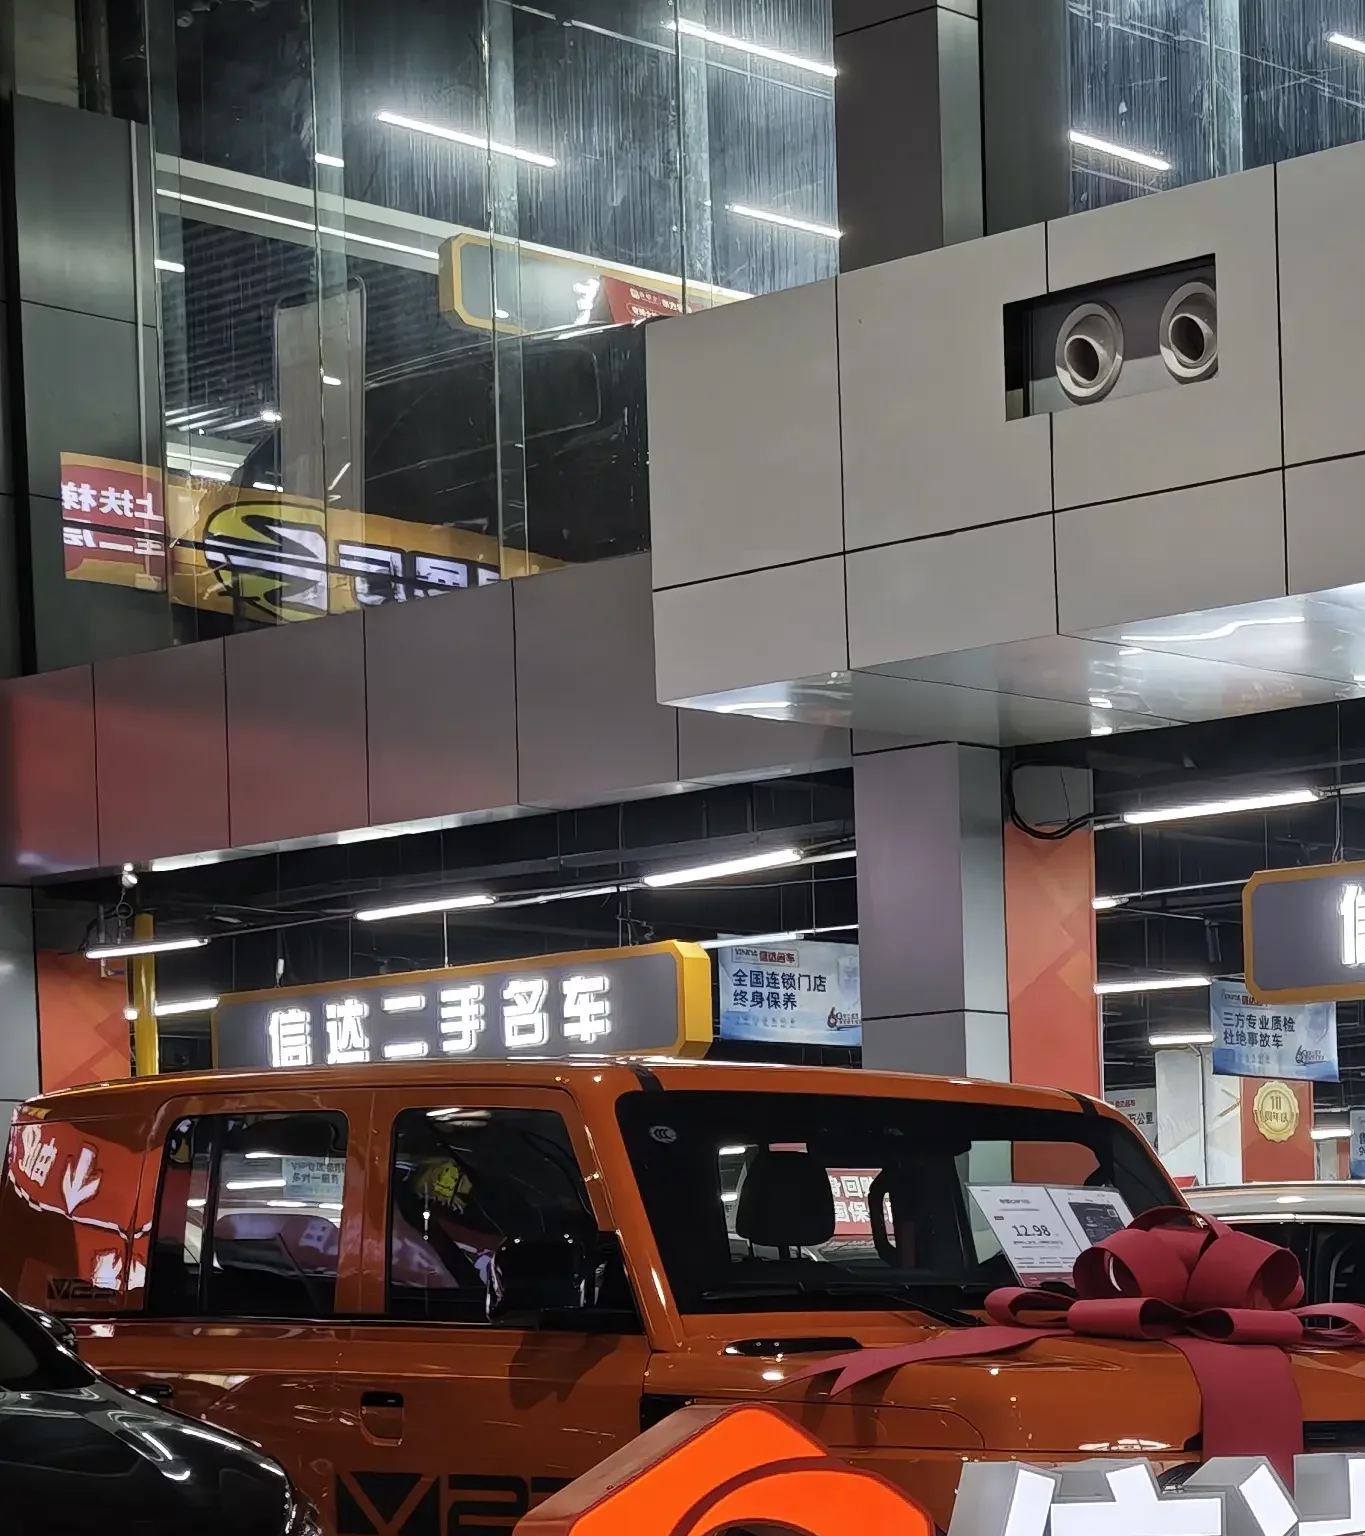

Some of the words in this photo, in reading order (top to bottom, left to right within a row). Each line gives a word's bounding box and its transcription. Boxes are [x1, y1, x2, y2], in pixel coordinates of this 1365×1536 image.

[732, 968, 827, 992] 全国连锁门店
[732, 989, 797, 1010] 终身保养
[267, 974, 612, 1068] 信达二手名车
[1222, 1011, 1296, 1033] 三方专业质检
[1222, 1030, 1284, 1049] 杜绝事故车
[1012, 1224, 1051, 1237] 12.98
